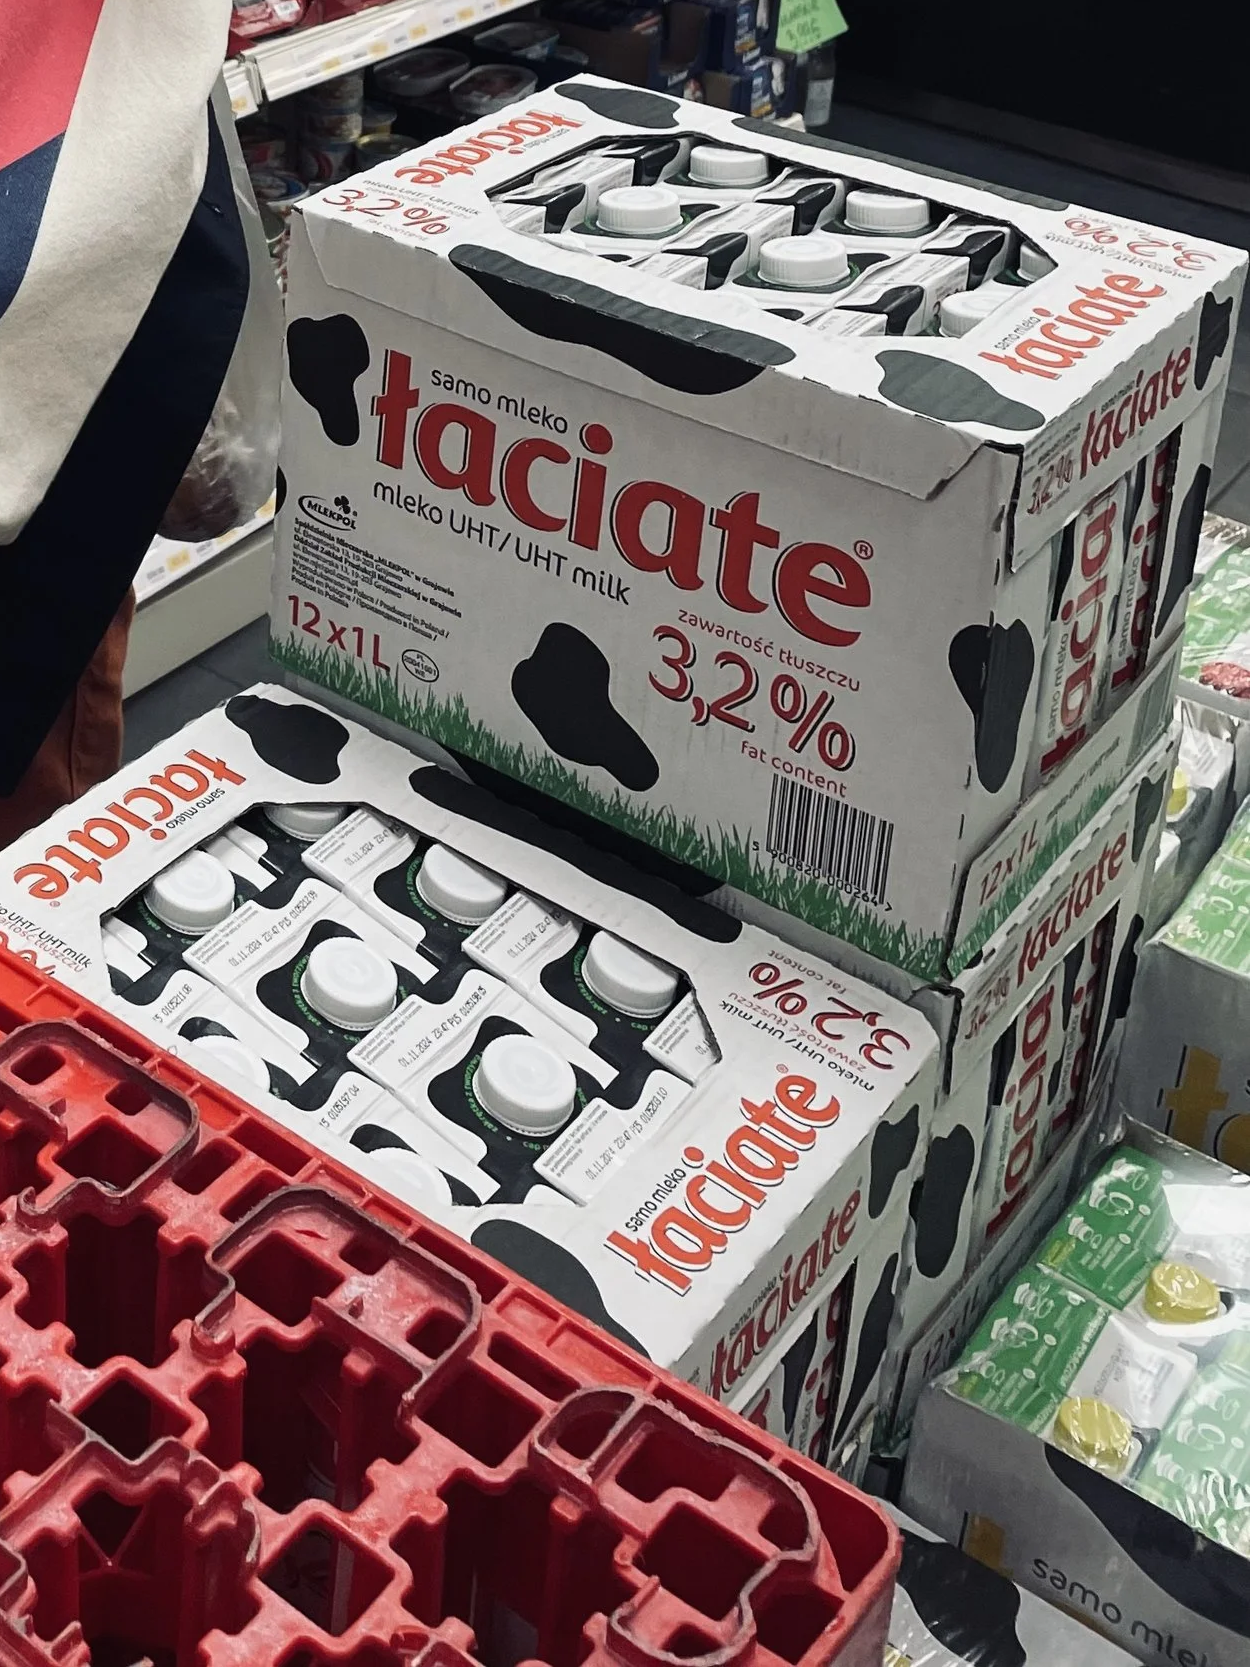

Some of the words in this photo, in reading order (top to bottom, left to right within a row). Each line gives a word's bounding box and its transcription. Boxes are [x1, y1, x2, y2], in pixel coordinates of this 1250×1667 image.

[321, 189, 452, 236] 3,2%
[1064, 215, 1217, 271] 3,2%
[978, 273, 1168, 382] łaciate
[994, 329, 1021, 350] samo
[1014, 316, 1042, 339] mleko
[431, 368, 492, 405] samo
[497, 393, 569, 434] mleko
[1080, 346, 1192, 481] łaciate
[307, 500, 357, 529] MLEKPOL
[371, 348, 872, 647] łaciate
[373, 481, 444, 525] mleko
[515, 538, 569, 579] UHT
[573, 566, 630, 606] milk
[678, 607, 775, 659] zawartość
[778, 645, 861, 692] tłuszczu
[648, 625, 856, 772] 3,2%
[197, 788, 225, 811] samo
[741, 740, 767, 763] fat
[771, 756, 848, 798] content
[13, 749, 247, 900] łaciate
[166, 803, 197, 830] mleko
[1017, 832, 1127, 989] łaciate
[63, 943, 93, 968] milk
[767, 949, 823, 982] content
[718, 1000, 752, 1023] milk
[748, 960, 911, 1071] 3,2%
[829, 981, 848, 993] fat
[798, 1024, 867, 1073] zawartość
[828, 1060, 875, 1092] mleko
[604, 1073, 841, 1297] łaciate
[624, 1195, 659, 1233] samo
[652, 1168, 687, 1205] mleko
[1031, 1556, 1123, 1626] samo
